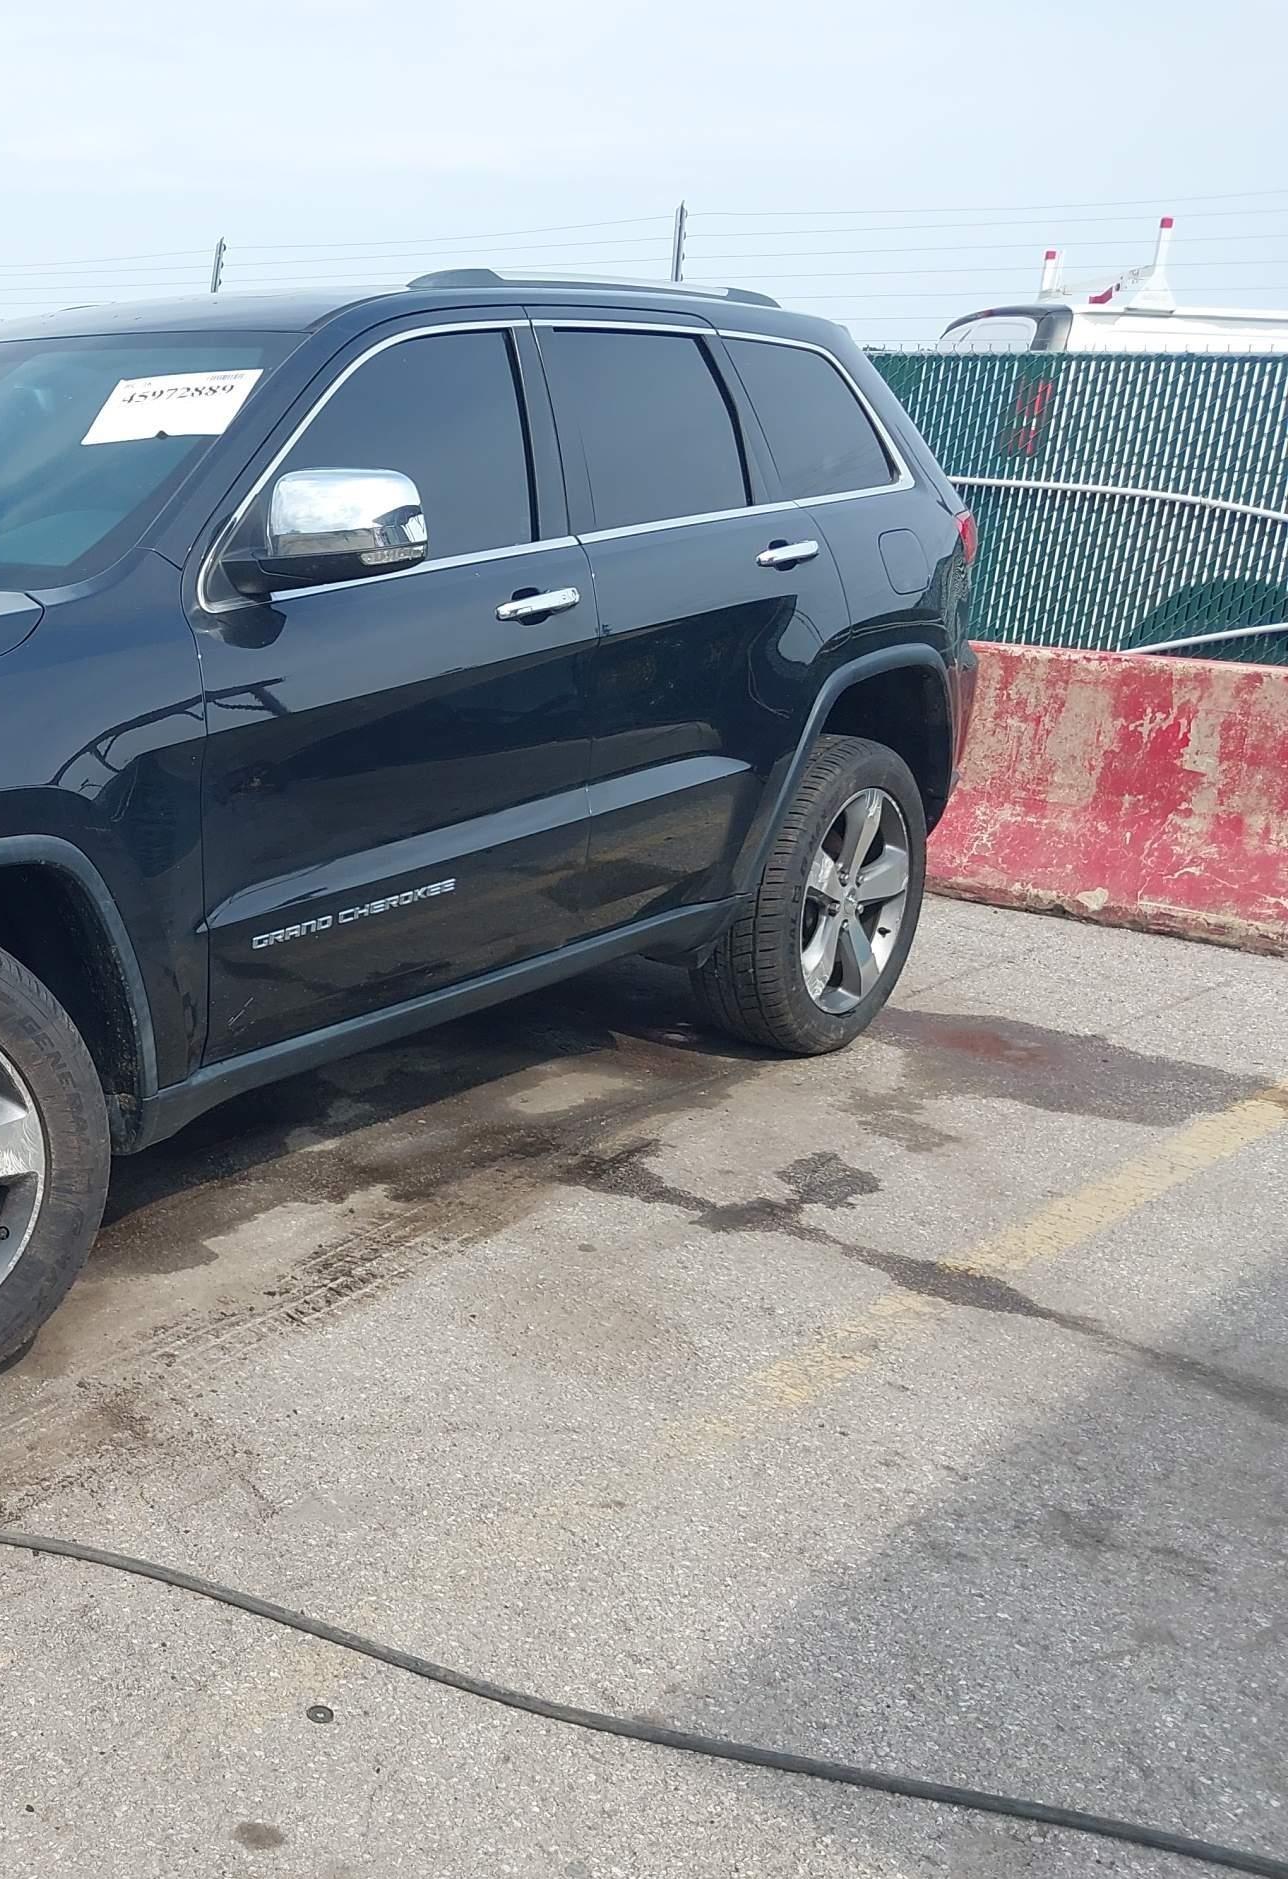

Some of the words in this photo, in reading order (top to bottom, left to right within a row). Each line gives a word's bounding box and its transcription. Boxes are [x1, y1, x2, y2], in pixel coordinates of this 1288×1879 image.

[122, 384, 235, 404] 45972889
[252, 915, 333, 950] GRAND
[338, 877, 457, 925] CHEROKEE
